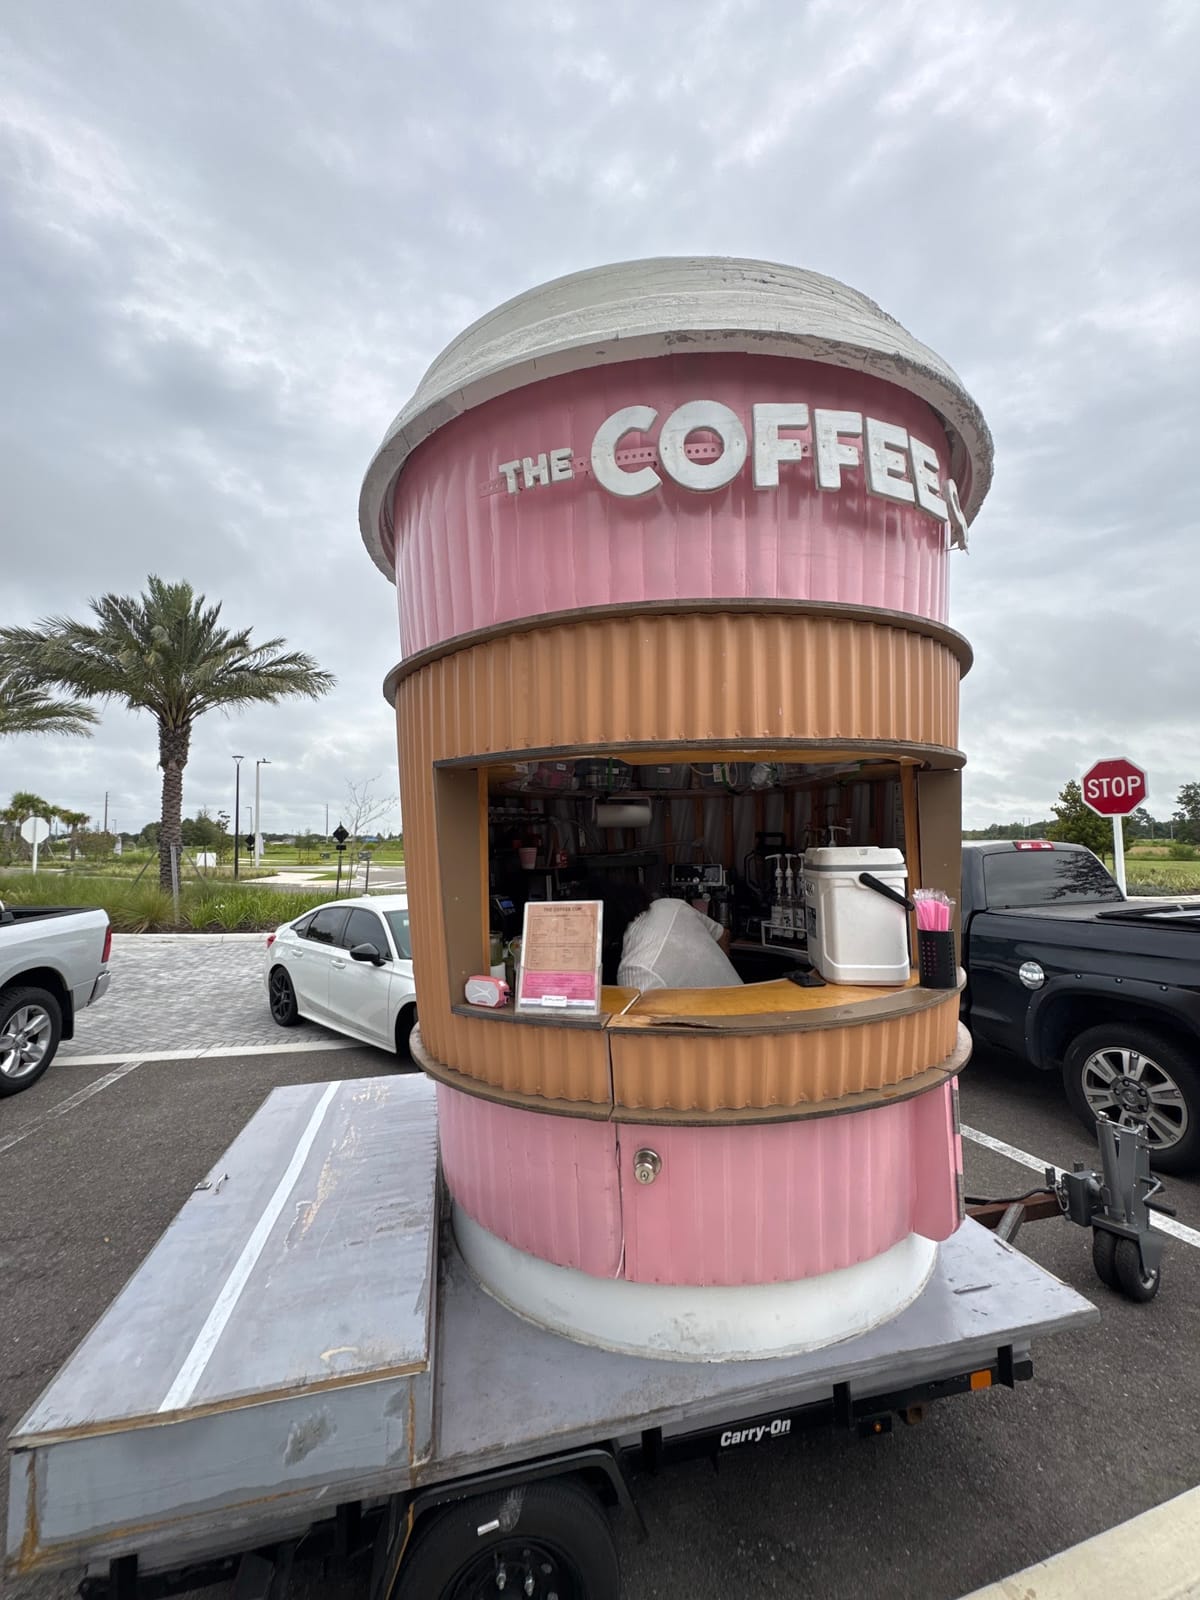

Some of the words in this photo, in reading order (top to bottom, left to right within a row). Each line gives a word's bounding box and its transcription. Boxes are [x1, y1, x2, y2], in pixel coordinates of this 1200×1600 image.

[499, 448, 575, 494] THE
[591, 400, 949, 523] COFFEE
[1087, 775, 1141, 799] STOP
[720, 1419, 792, 1447] Carry-On
